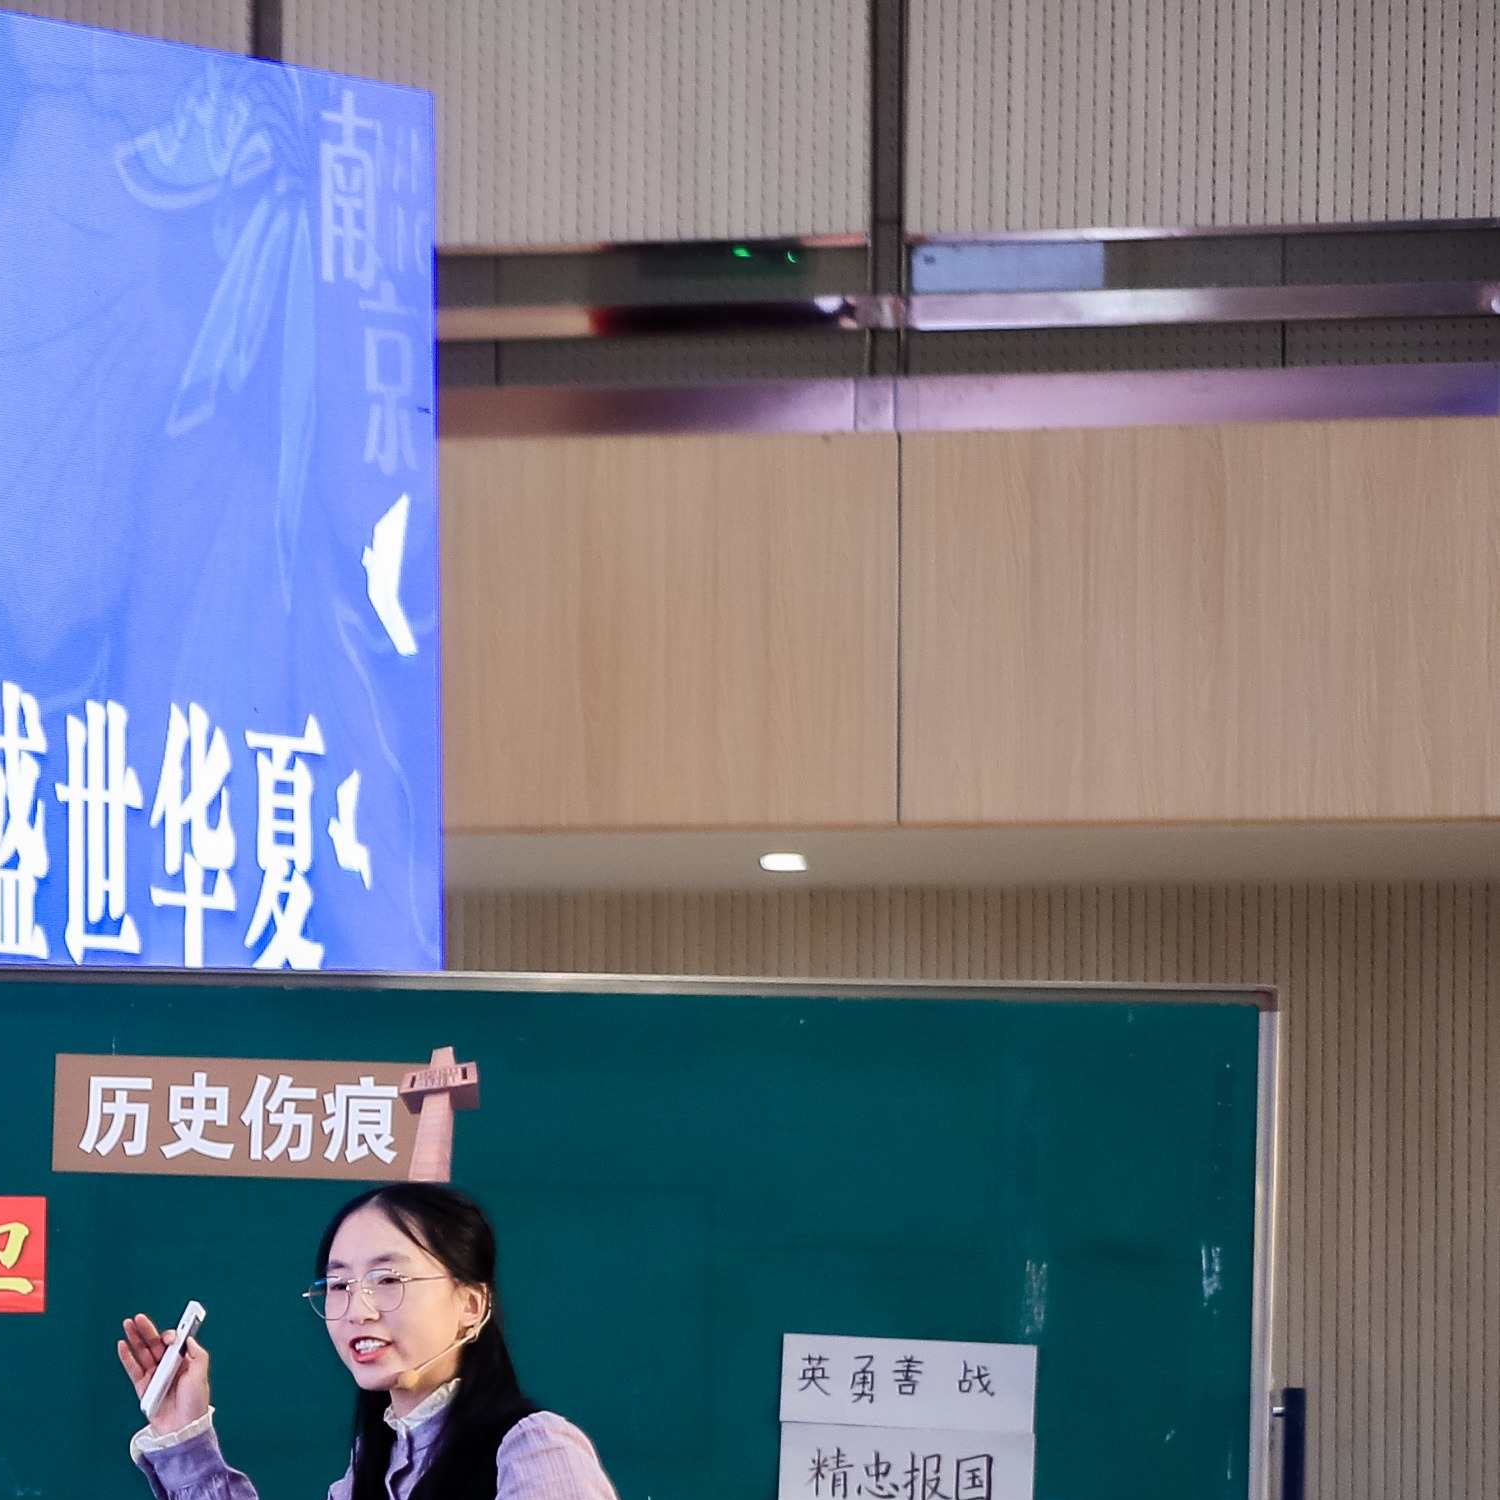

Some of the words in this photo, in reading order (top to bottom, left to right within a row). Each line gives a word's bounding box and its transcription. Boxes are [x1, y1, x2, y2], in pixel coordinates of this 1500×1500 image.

[79, 1071, 399, 1164] 历史伤痕
[798, 1353, 996, 1404] 英勇善战
